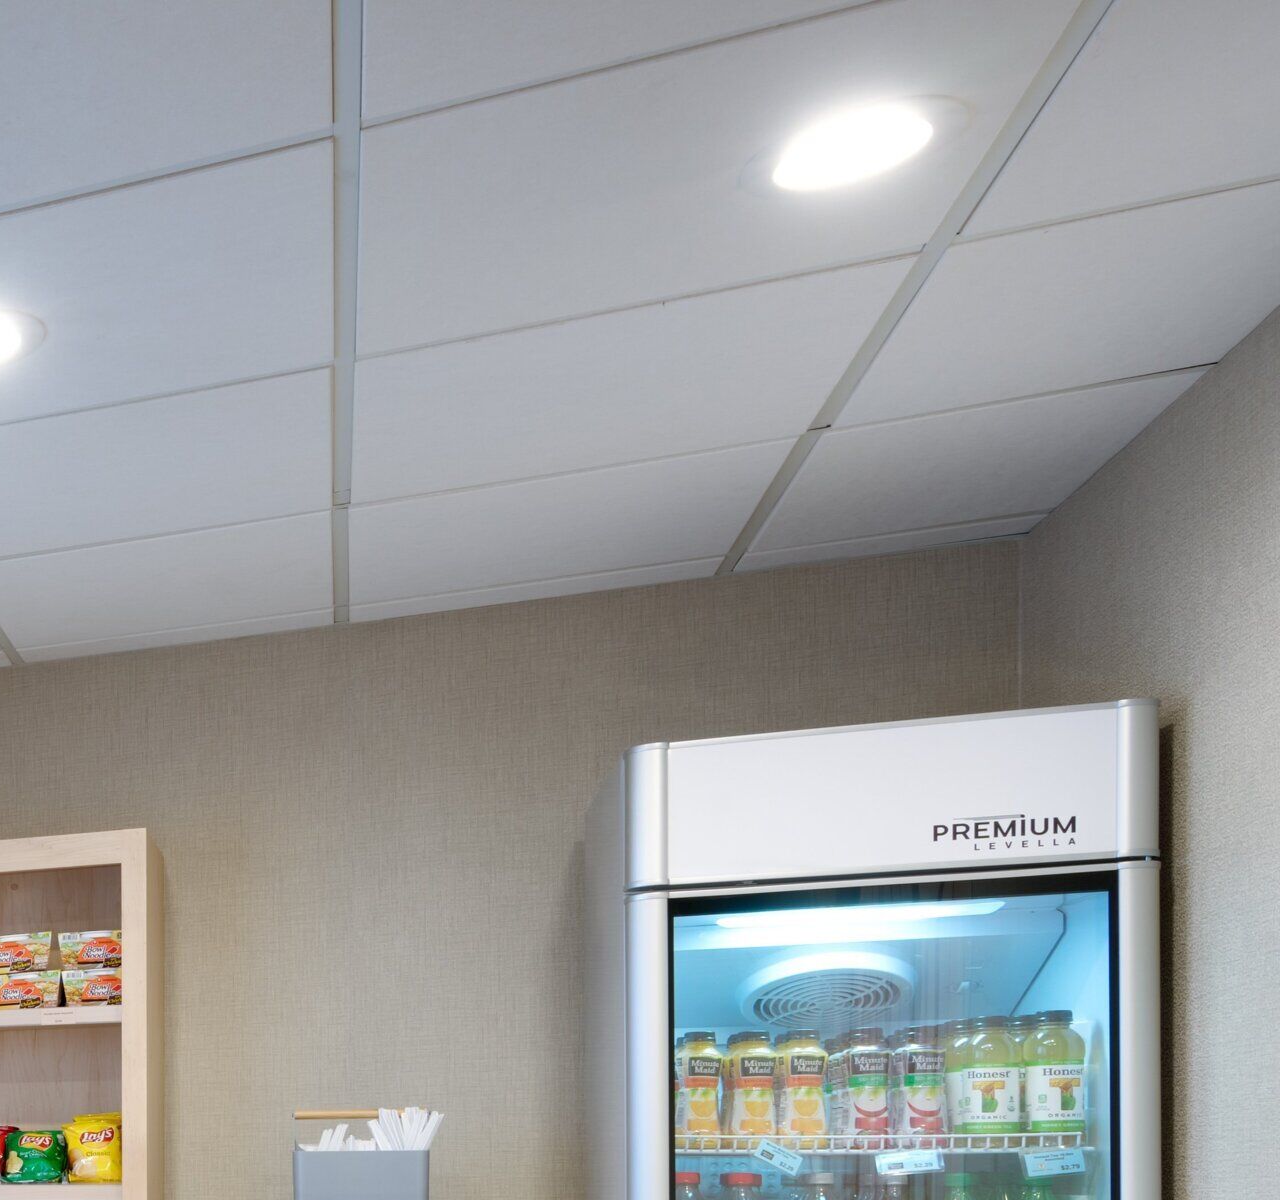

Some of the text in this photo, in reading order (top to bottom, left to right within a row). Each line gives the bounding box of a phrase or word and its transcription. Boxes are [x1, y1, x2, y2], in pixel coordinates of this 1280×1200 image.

[974, 837, 1076, 851] LEVELLA
[83, 950, 111, 959] Noodle
[691, 1060, 720, 1068] Minute
[744, 1060, 774, 1068] Minute
[694, 1066, 715, 1074] Maid
[749, 1066, 771, 1074] Maid
[967, 1071, 1010, 1079] Honest
[79, 1128, 115, 1145] Lay's
[21, 1134, 53, 1148] Lay's
[86, 1150, 111, 1158] Classic
